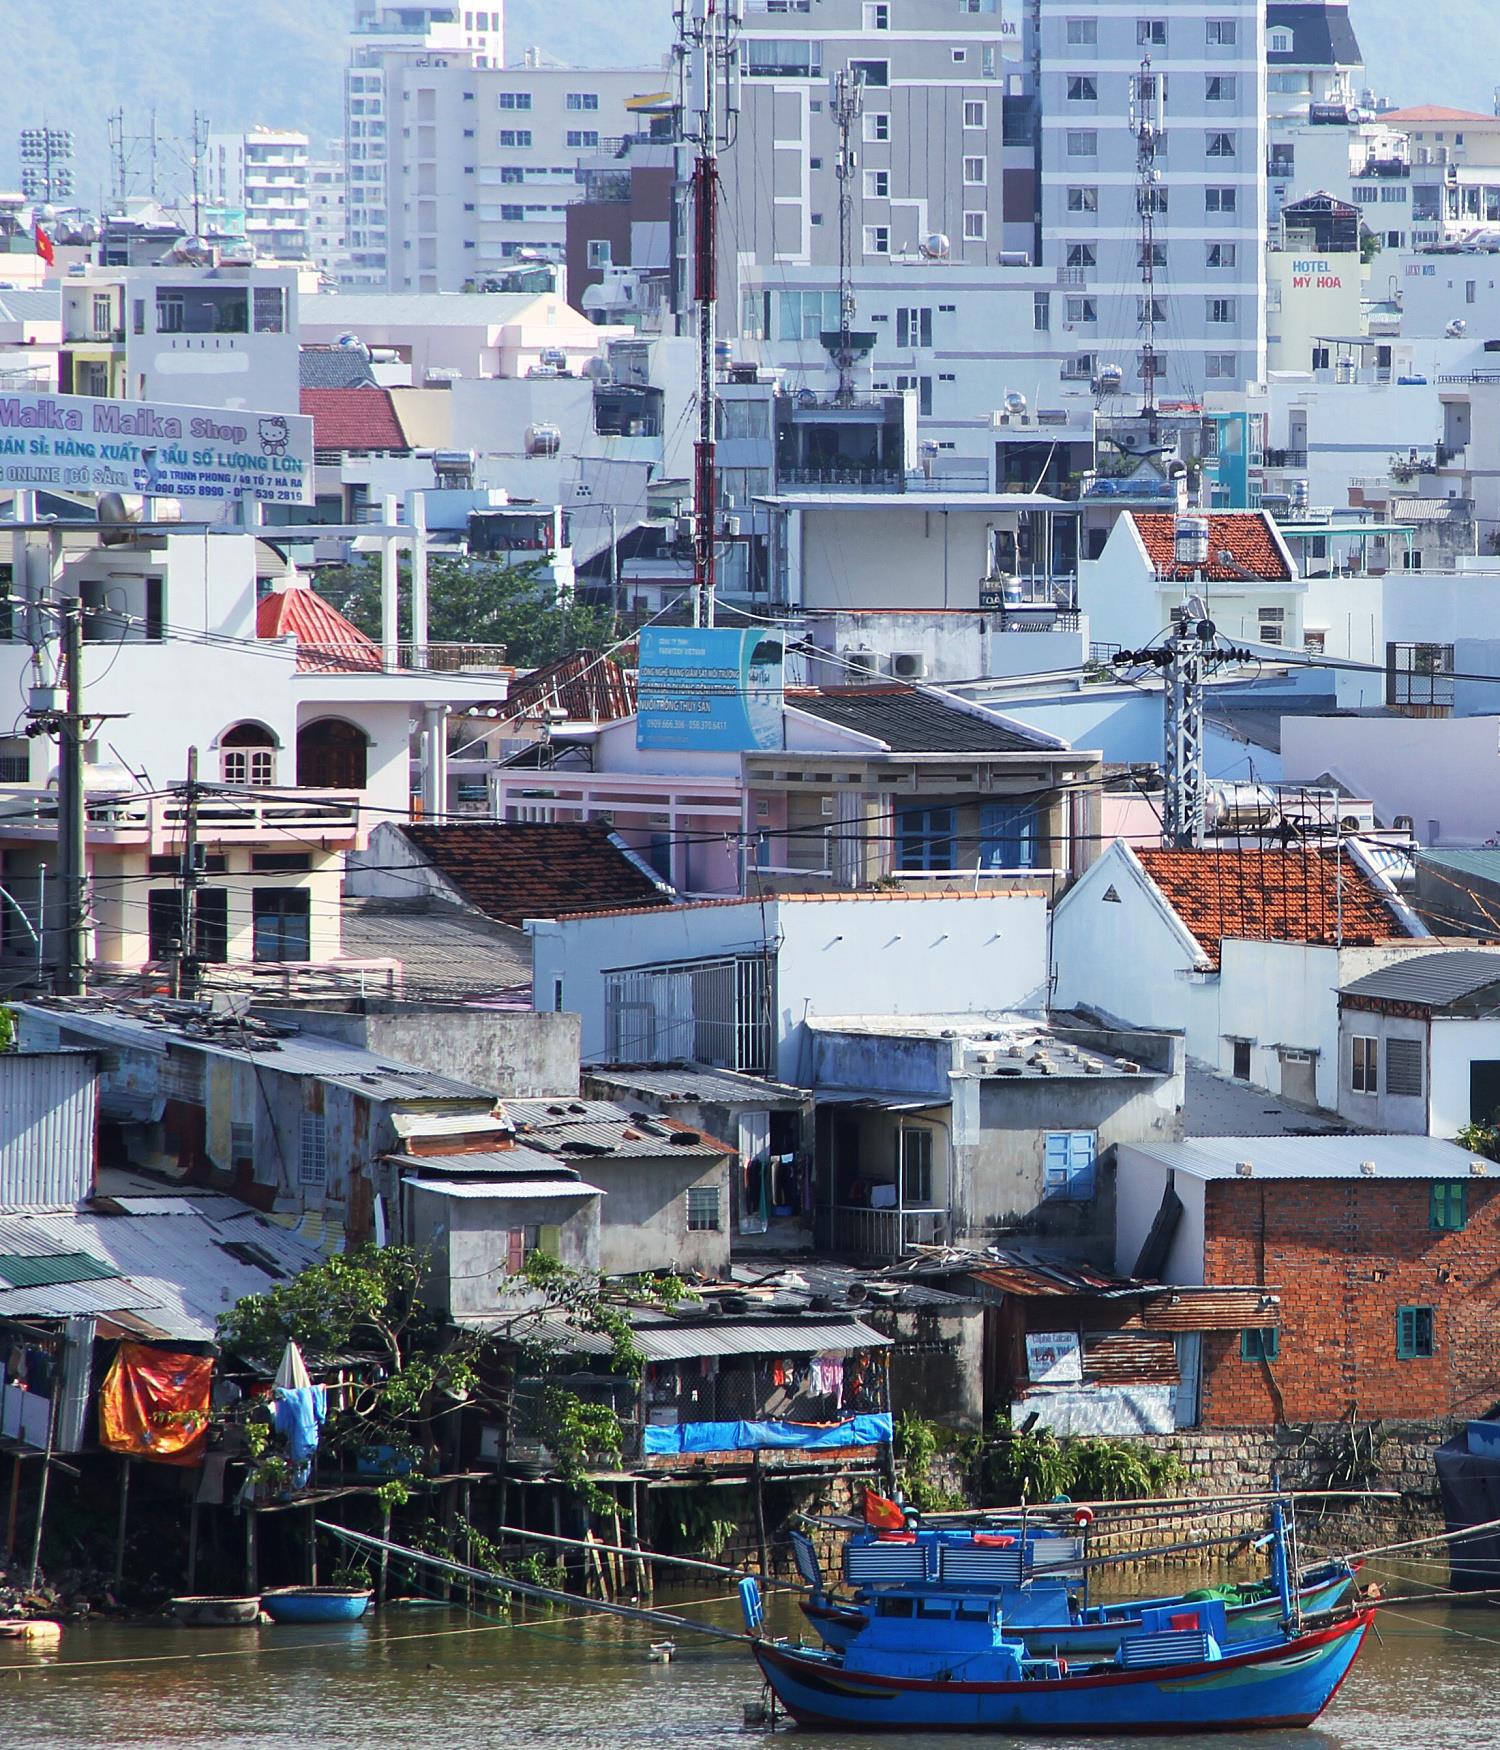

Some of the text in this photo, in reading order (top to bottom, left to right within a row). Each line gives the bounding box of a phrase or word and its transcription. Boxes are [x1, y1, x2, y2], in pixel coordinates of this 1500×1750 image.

[1293, 260, 1331, 273] HOTEL
[1317, 276, 1341, 288] HOA
[0, 398, 247, 444] Maika Maika Shop
[55, 437, 96, 458] HÀNG
[193, 447, 216, 467] SỐ
[7, 466, 60, 482] ONLINE
[199, 472, 231, 483] PHONG
[267, 477, 272, 486] 7
[291, 478, 302, 488] RA
[155, 484, 174, 494] 090
[177, 484, 195, 495] 555
[199, 485, 224, 496] 8990
[255, 489, 274, 499] 539
[277, 490, 303, 501] 2819
